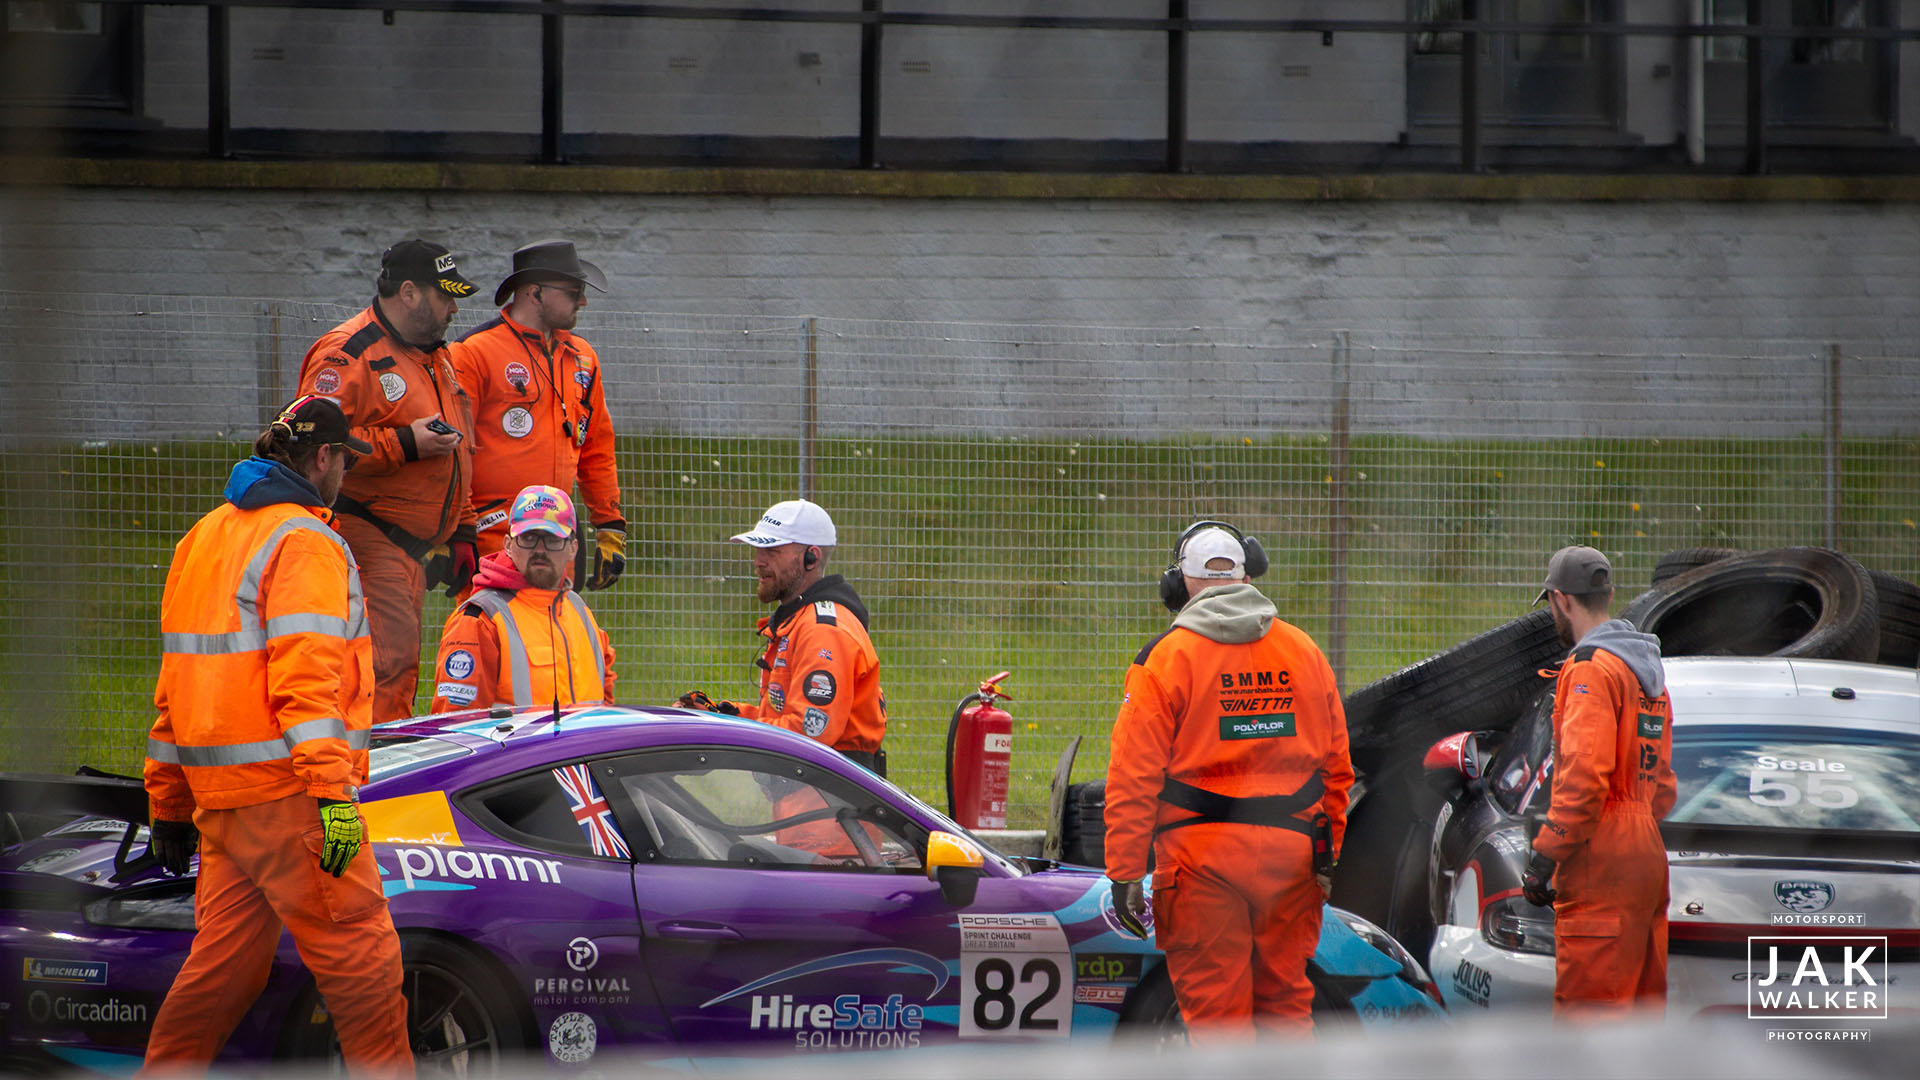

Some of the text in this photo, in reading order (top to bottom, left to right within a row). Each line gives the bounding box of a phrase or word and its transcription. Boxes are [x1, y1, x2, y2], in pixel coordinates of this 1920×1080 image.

[477, 512, 506, 529] CHELIN
[762, 515, 782, 527] YEAR
[1219, 686, 1293, 695] www.marshals.co.uk
[1219, 697, 1294, 712] GINETTA
[1233, 721, 1284, 732] POLYFLOR
[1755, 756, 1846, 772] Seale
[1749, 770, 1859, 809] 55
[395, 846, 564, 889] plannr
[961, 917, 1048, 926] PORSCHE
[963, 931, 1032, 940] SPRINT CHALLENGE
[964, 941, 1016, 949] GREAT BRITAIN
[44, 966, 99, 978] MICHELIN
[1077, 955, 1125, 981] rdp
[535, 978, 631, 993] PERCIVAL
[534, 994, 631, 1005] motor company
[973, 957, 1062, 1031] 82
[54, 997, 147, 1022] Circadian
[750, 994, 925, 1030] HireSafe
[550, 1013, 585, 1042] TRIPLE
[795, 1031, 921, 1049] SOLUTIONS
